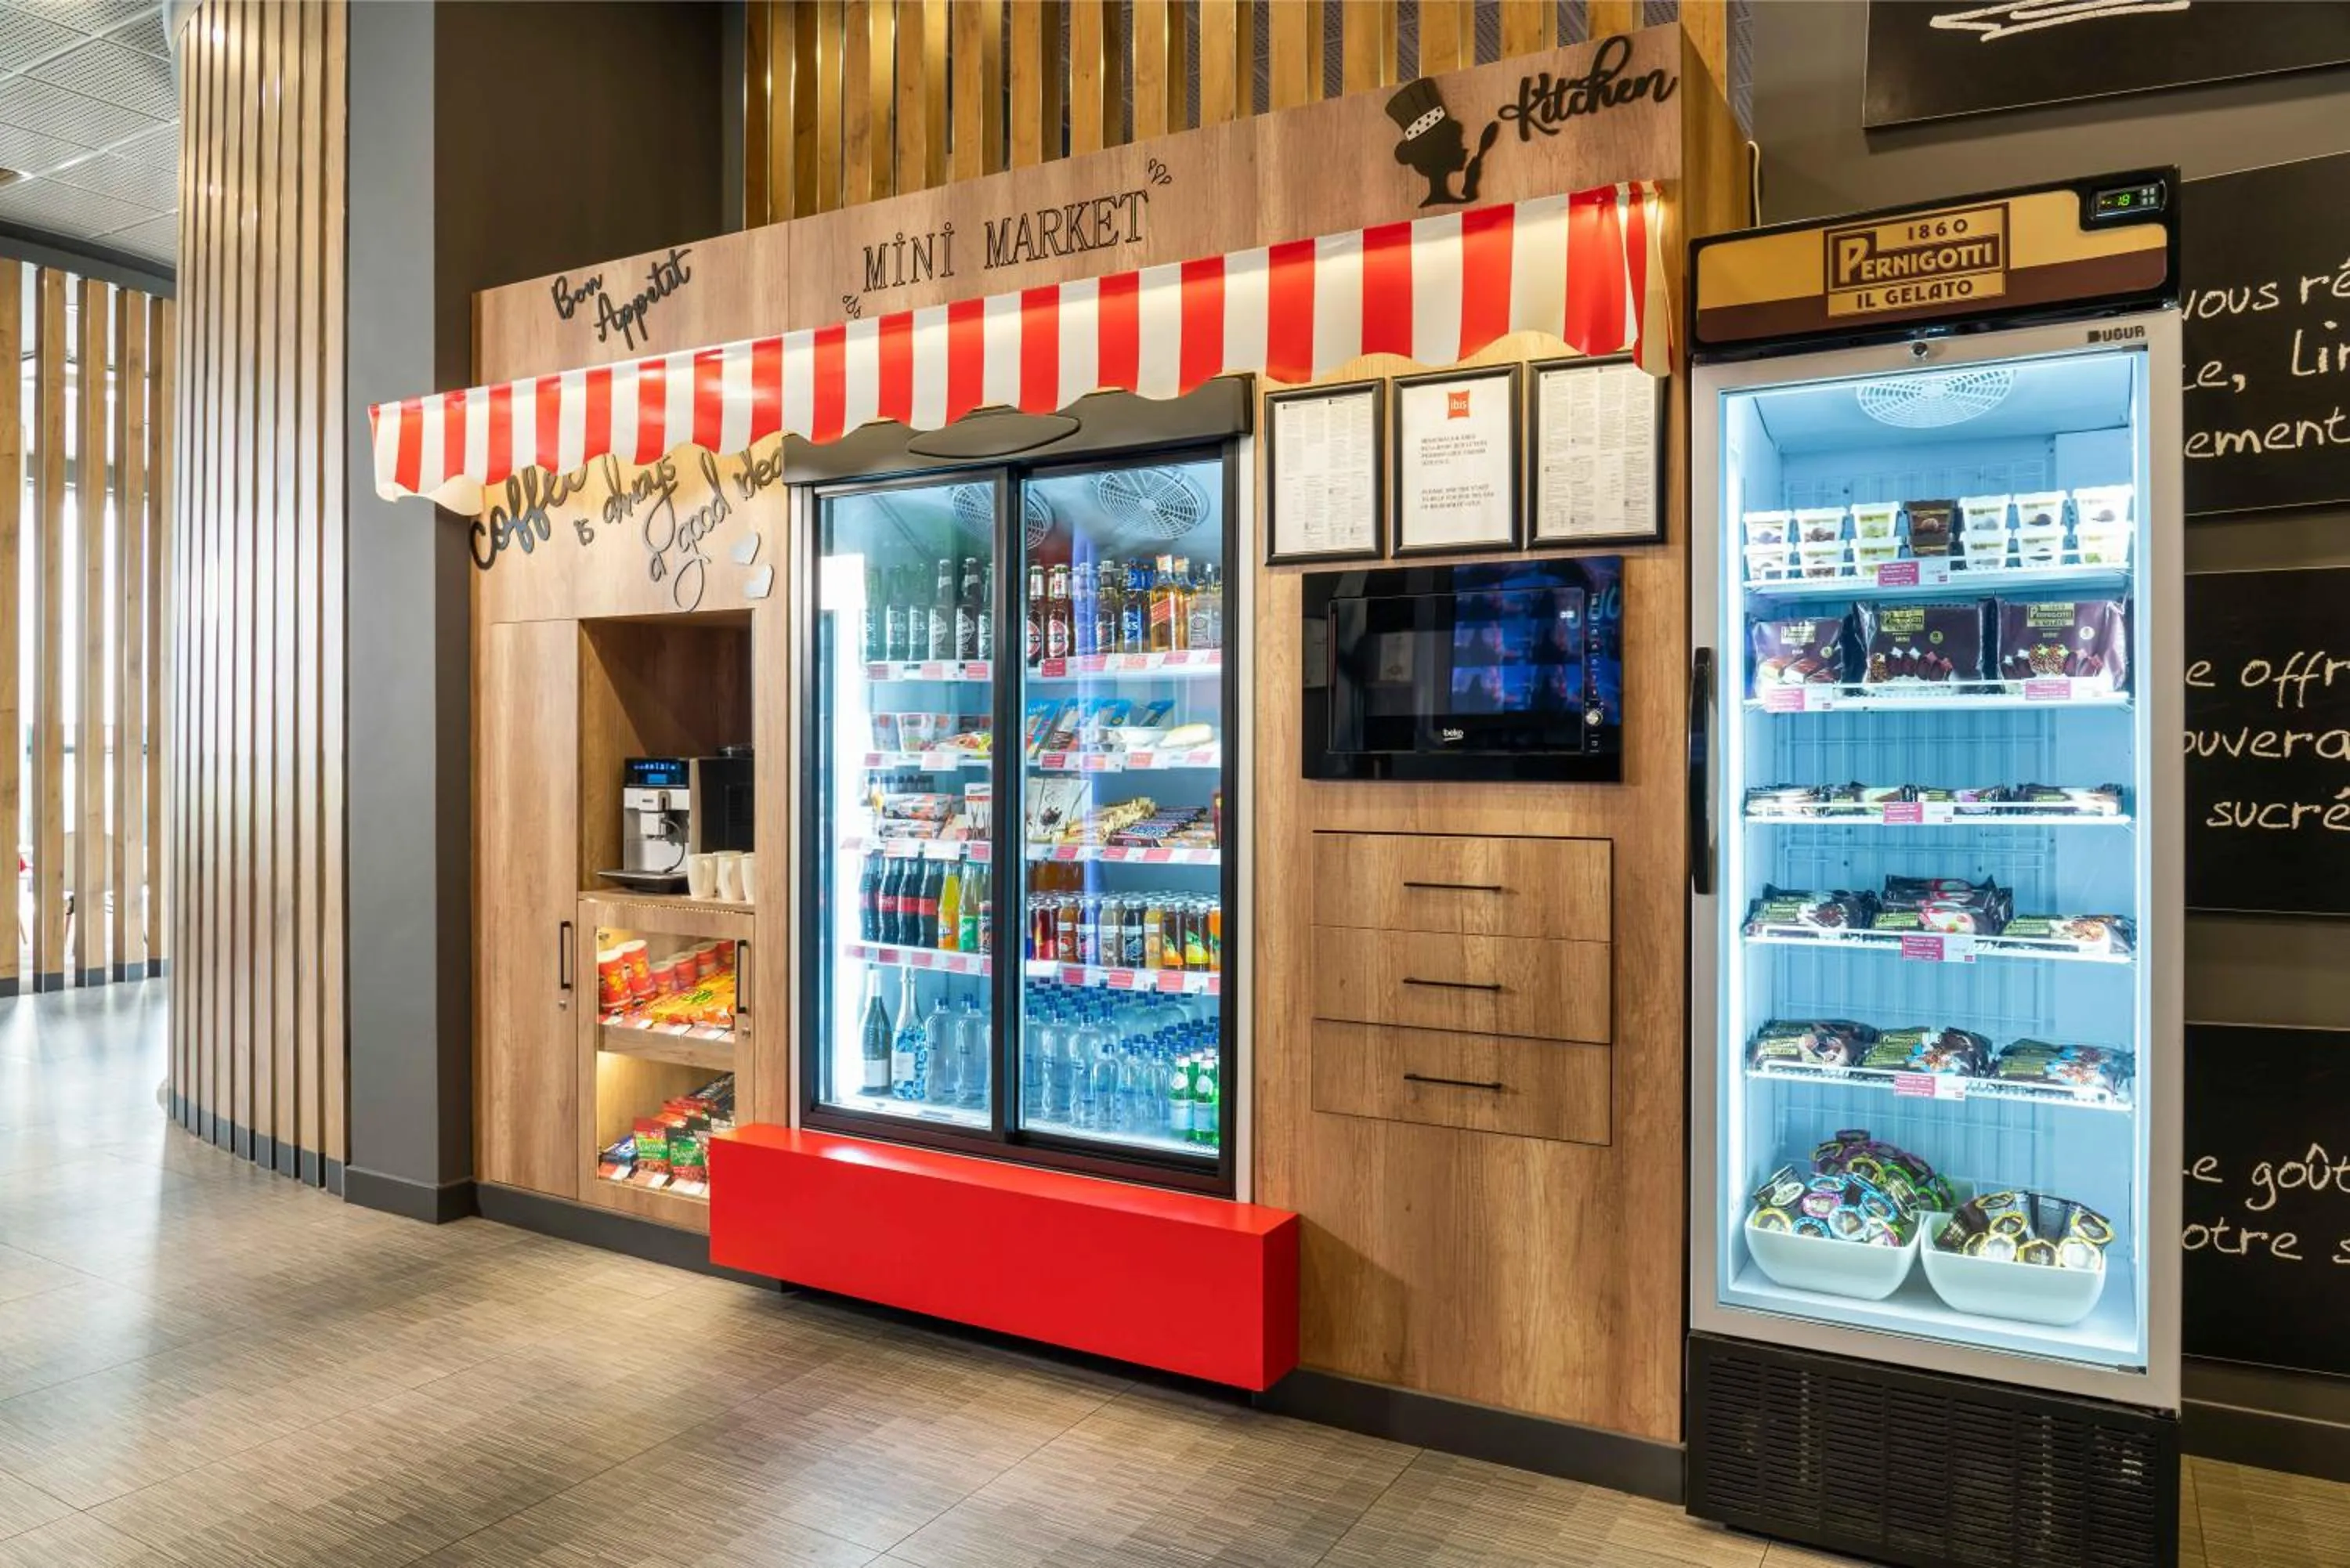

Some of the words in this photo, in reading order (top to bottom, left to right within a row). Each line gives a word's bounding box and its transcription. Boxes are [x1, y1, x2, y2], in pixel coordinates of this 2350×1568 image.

[1498, 35, 1678, 142] Kitchen
[984, 189, 1149, 270] MARKET
[1908, 219, 1969, 240] 1860
[1838, 237, 1992, 284] PERNIGOTTI
[551, 274, 602, 320] Bon
[1856, 292, 1876, 310] IL
[1885, 279, 1973, 306] GELATO
[2182, 361, 2246, 392] e,
[1450, 397, 1467, 411] ibis
[2184, 406, 2350, 457] ement
[672, 450, 733, 612] good
[2206, 786, 2350, 830] sucré
[2182, 1155, 2223, 1182] e
[2245, 1143, 2350, 1211] goût
